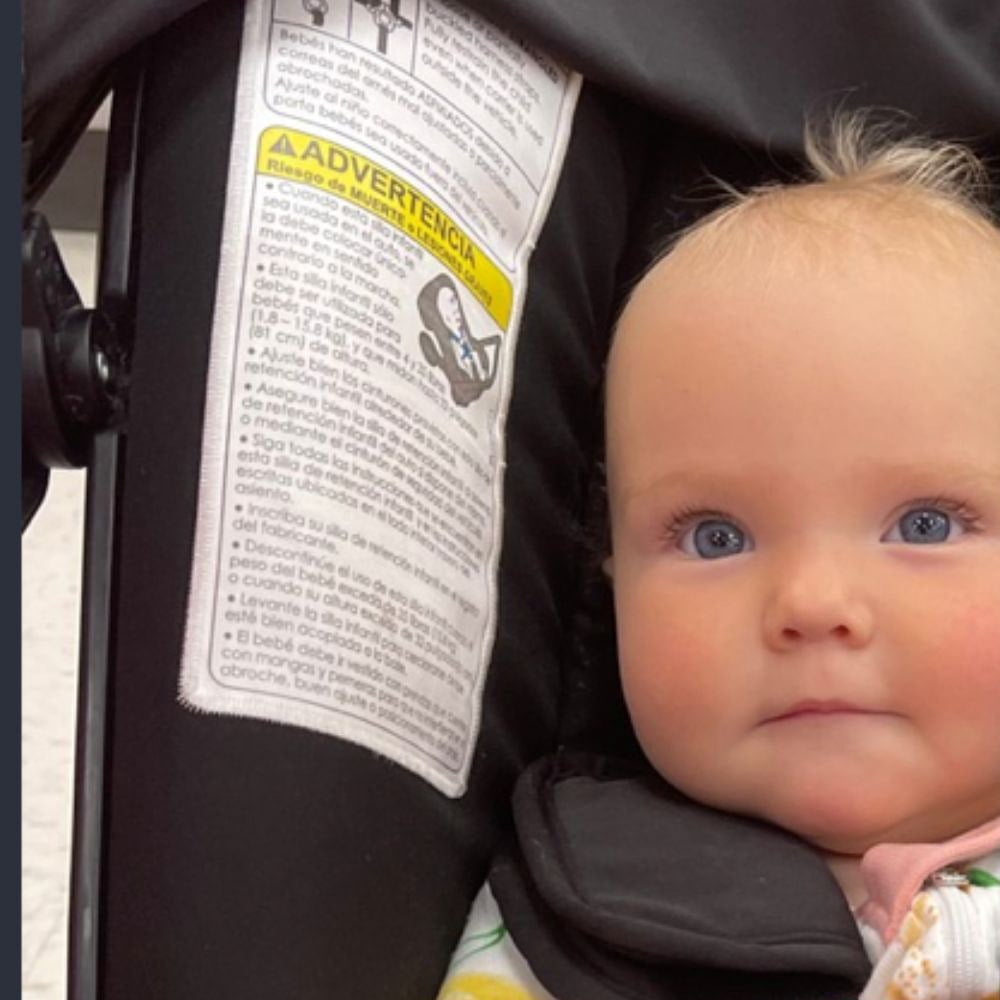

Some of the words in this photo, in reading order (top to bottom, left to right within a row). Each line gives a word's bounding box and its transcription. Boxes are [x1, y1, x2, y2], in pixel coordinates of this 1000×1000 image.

[277, 47, 334, 70] correas
[273, 77, 320, 98] Ajuste
[267, 158, 325, 186] Riesgo
[328, 178, 346, 194] de
[350, 186, 406, 228] MUERTE
[278, 181, 339, 211] Cuando
[302, 139, 476, 270] ADVERTENCIA
[262, 195, 291, 212] sea
[293, 202, 339, 228] usada
[261, 209, 276, 224] la
[278, 213, 320, 235] debe
[322, 229, 372, 257] colocar
[257, 242, 325, 269] contrario
[259, 227, 308, 248] mente
[312, 242, 331, 256] en
[334, 249, 379, 279] sentido
[269, 263, 299, 281] Esta
[330, 279, 371, 309] infantil
[252, 293, 299, 314] bebés
[302, 306, 331, 325] que
[253, 278, 296, 296] debe
[299, 289, 319, 304] ser
[322, 298, 374, 328] utilizada
[260, 347, 305, 367] Ajuste
[309, 357, 339, 376] bien
[310, 339, 330, 355] de
[244, 361, 317, 388] retención
[319, 378, 362, 405] infantil
[242, 398, 262, 411] de
[265, 402, 336, 431] retención
[256, 382, 318, 408] Asegure
[320, 398, 351, 419] bien
[240, 414, 250, 425] o
[255, 416, 326, 444] mediante
[237, 450, 269, 466] esta
[275, 456, 300, 472] silla
[303, 464, 322, 478] de
[252, 433, 286, 452] Siga
[289, 440, 329, 465] todas
[237, 466, 293, 487] escritas
[296, 479, 358, 509] ubicadas
[232, 518, 257, 533] del
[247, 503, 305, 527] Inscriba
[229, 555, 267, 571] peso
[271, 563, 296, 578] del
[245, 538, 335, 572] Descontinúe
[227, 573, 238, 584] o
[242, 574, 303, 597] cuando
[305, 589, 319, 602] su
[240, 592, 301, 616] Levante
[304, 605, 318, 622] la
[260, 610, 293, 629] bien
[237, 629, 250, 644] El
[253, 633, 292, 653] bebé
[297, 644, 334, 665] debe
[221, 648, 252, 661] con
[256, 652, 314, 678] mangas
